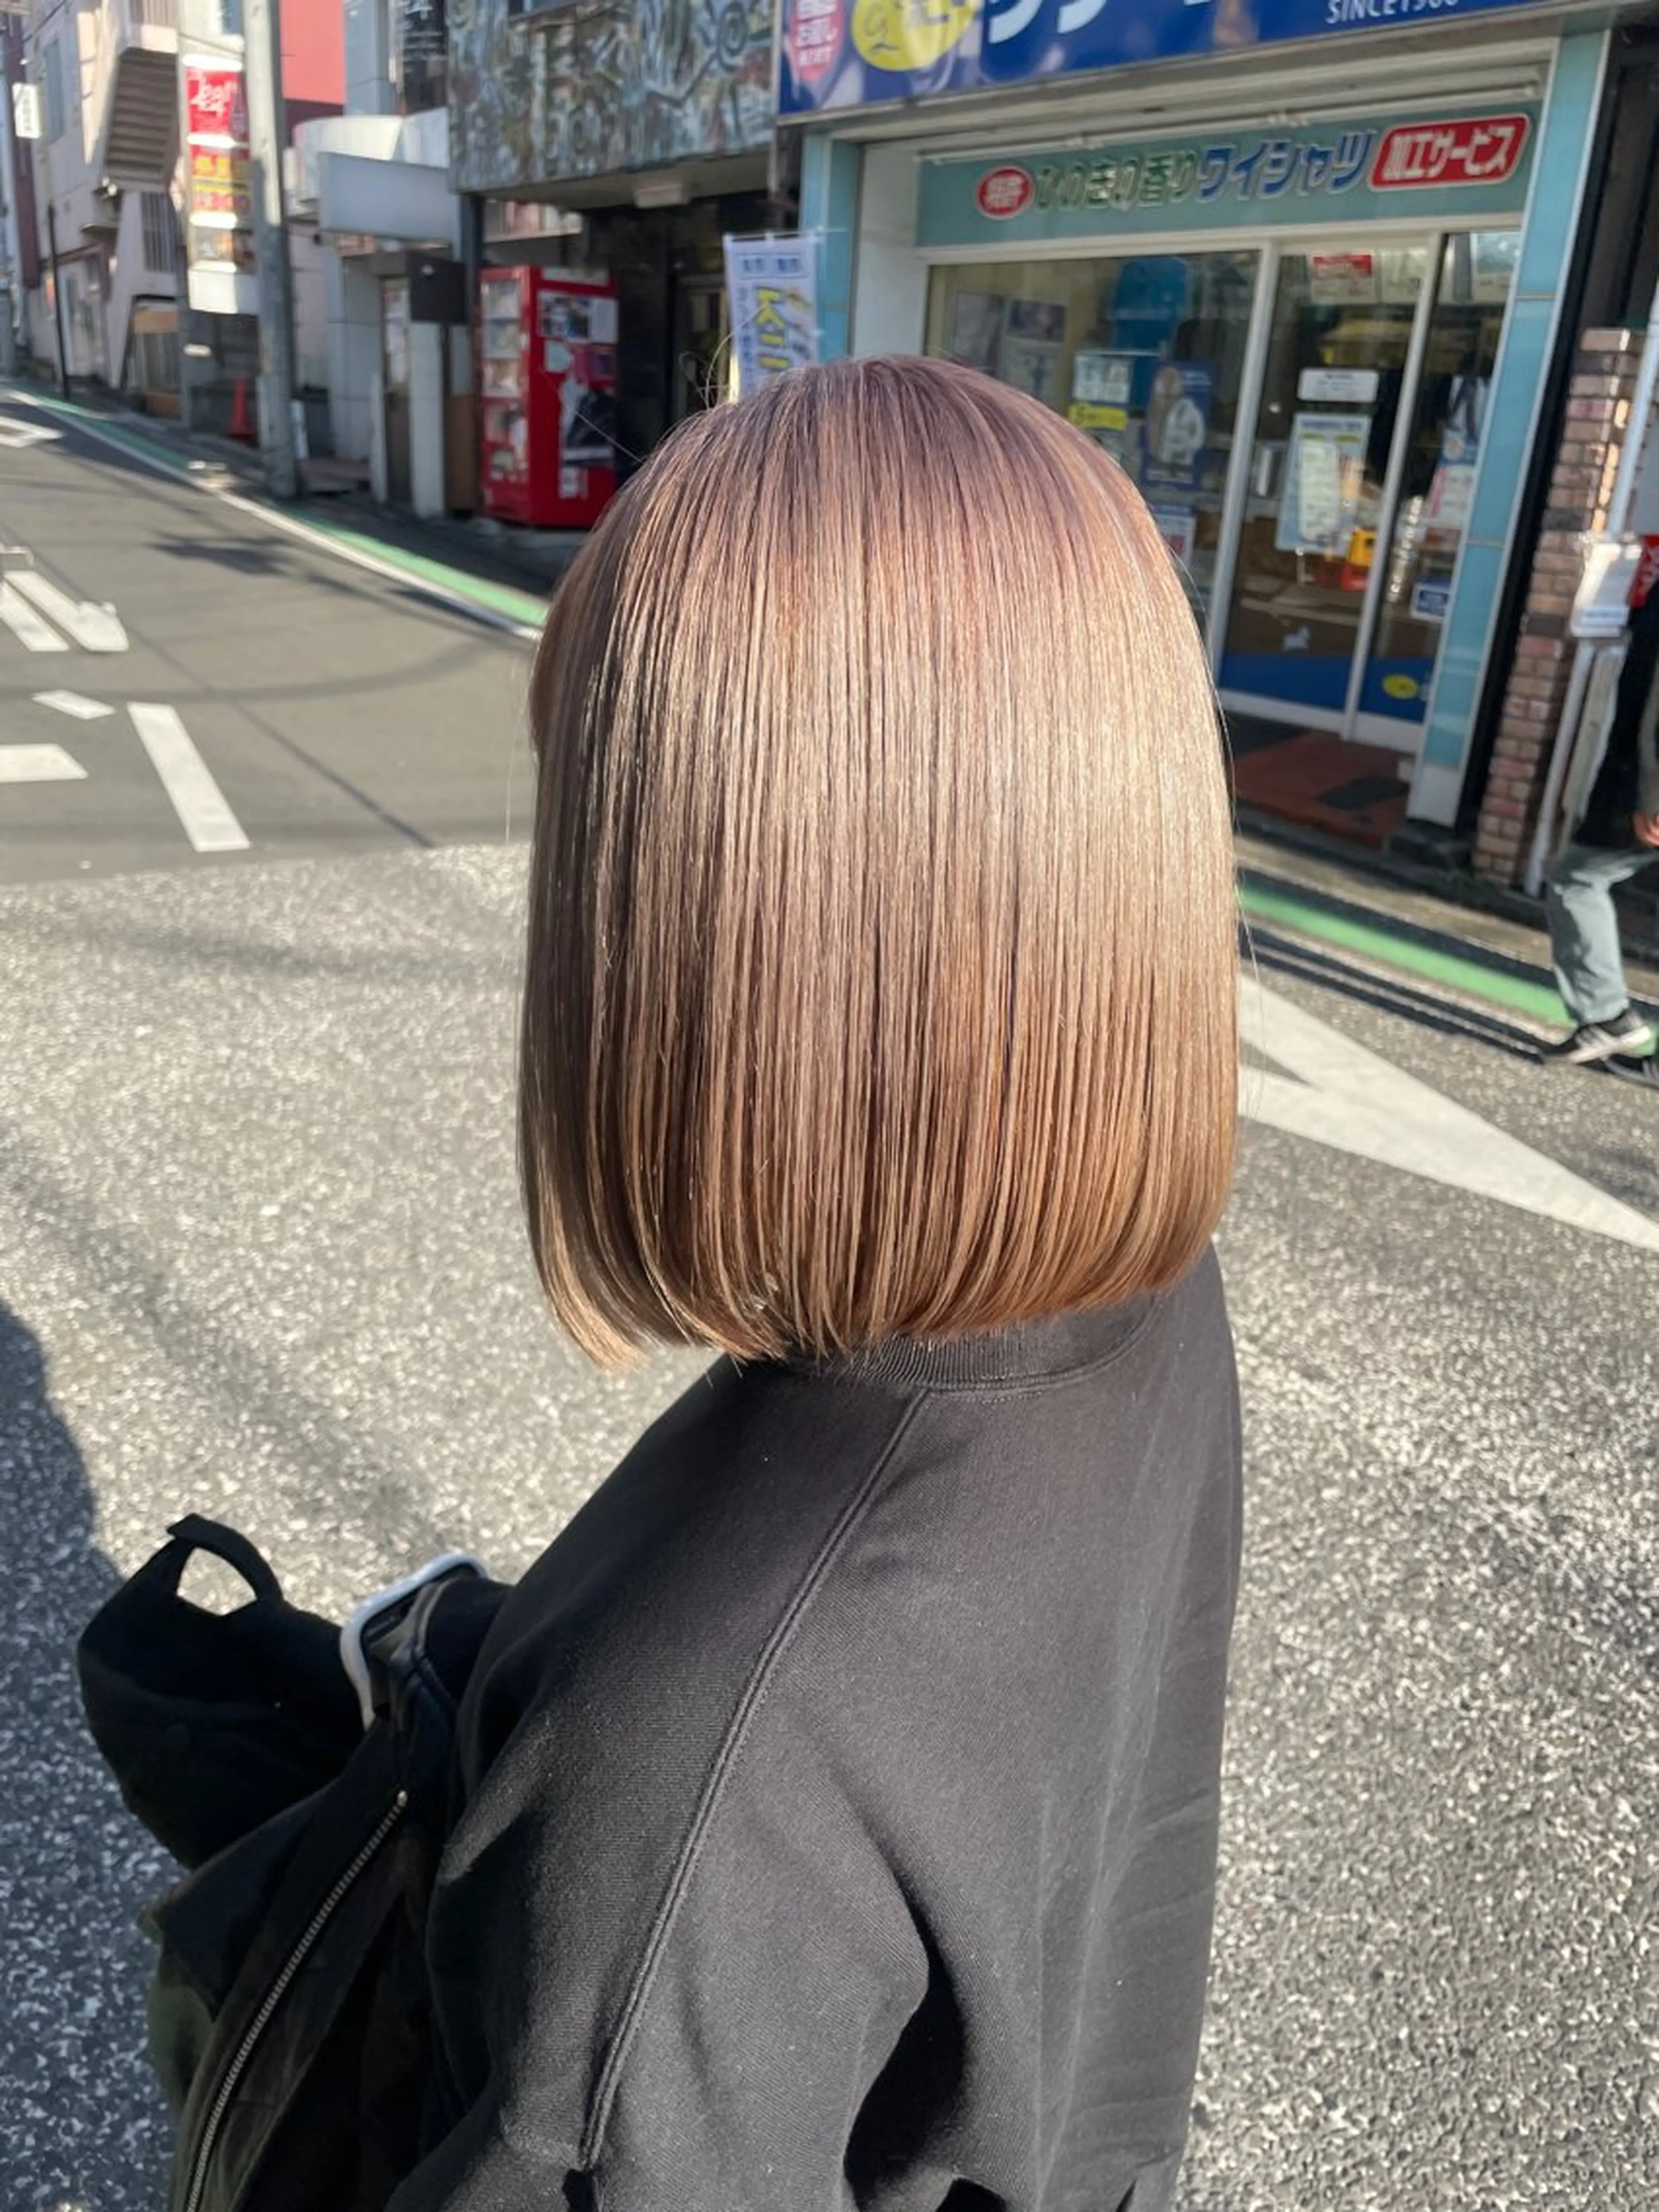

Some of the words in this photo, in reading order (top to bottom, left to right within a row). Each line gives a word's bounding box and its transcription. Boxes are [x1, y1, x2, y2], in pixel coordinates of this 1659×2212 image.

[1198, 130, 1376, 203] ワイシャツ
[1382, 125, 1516, 180] 加工サービス
